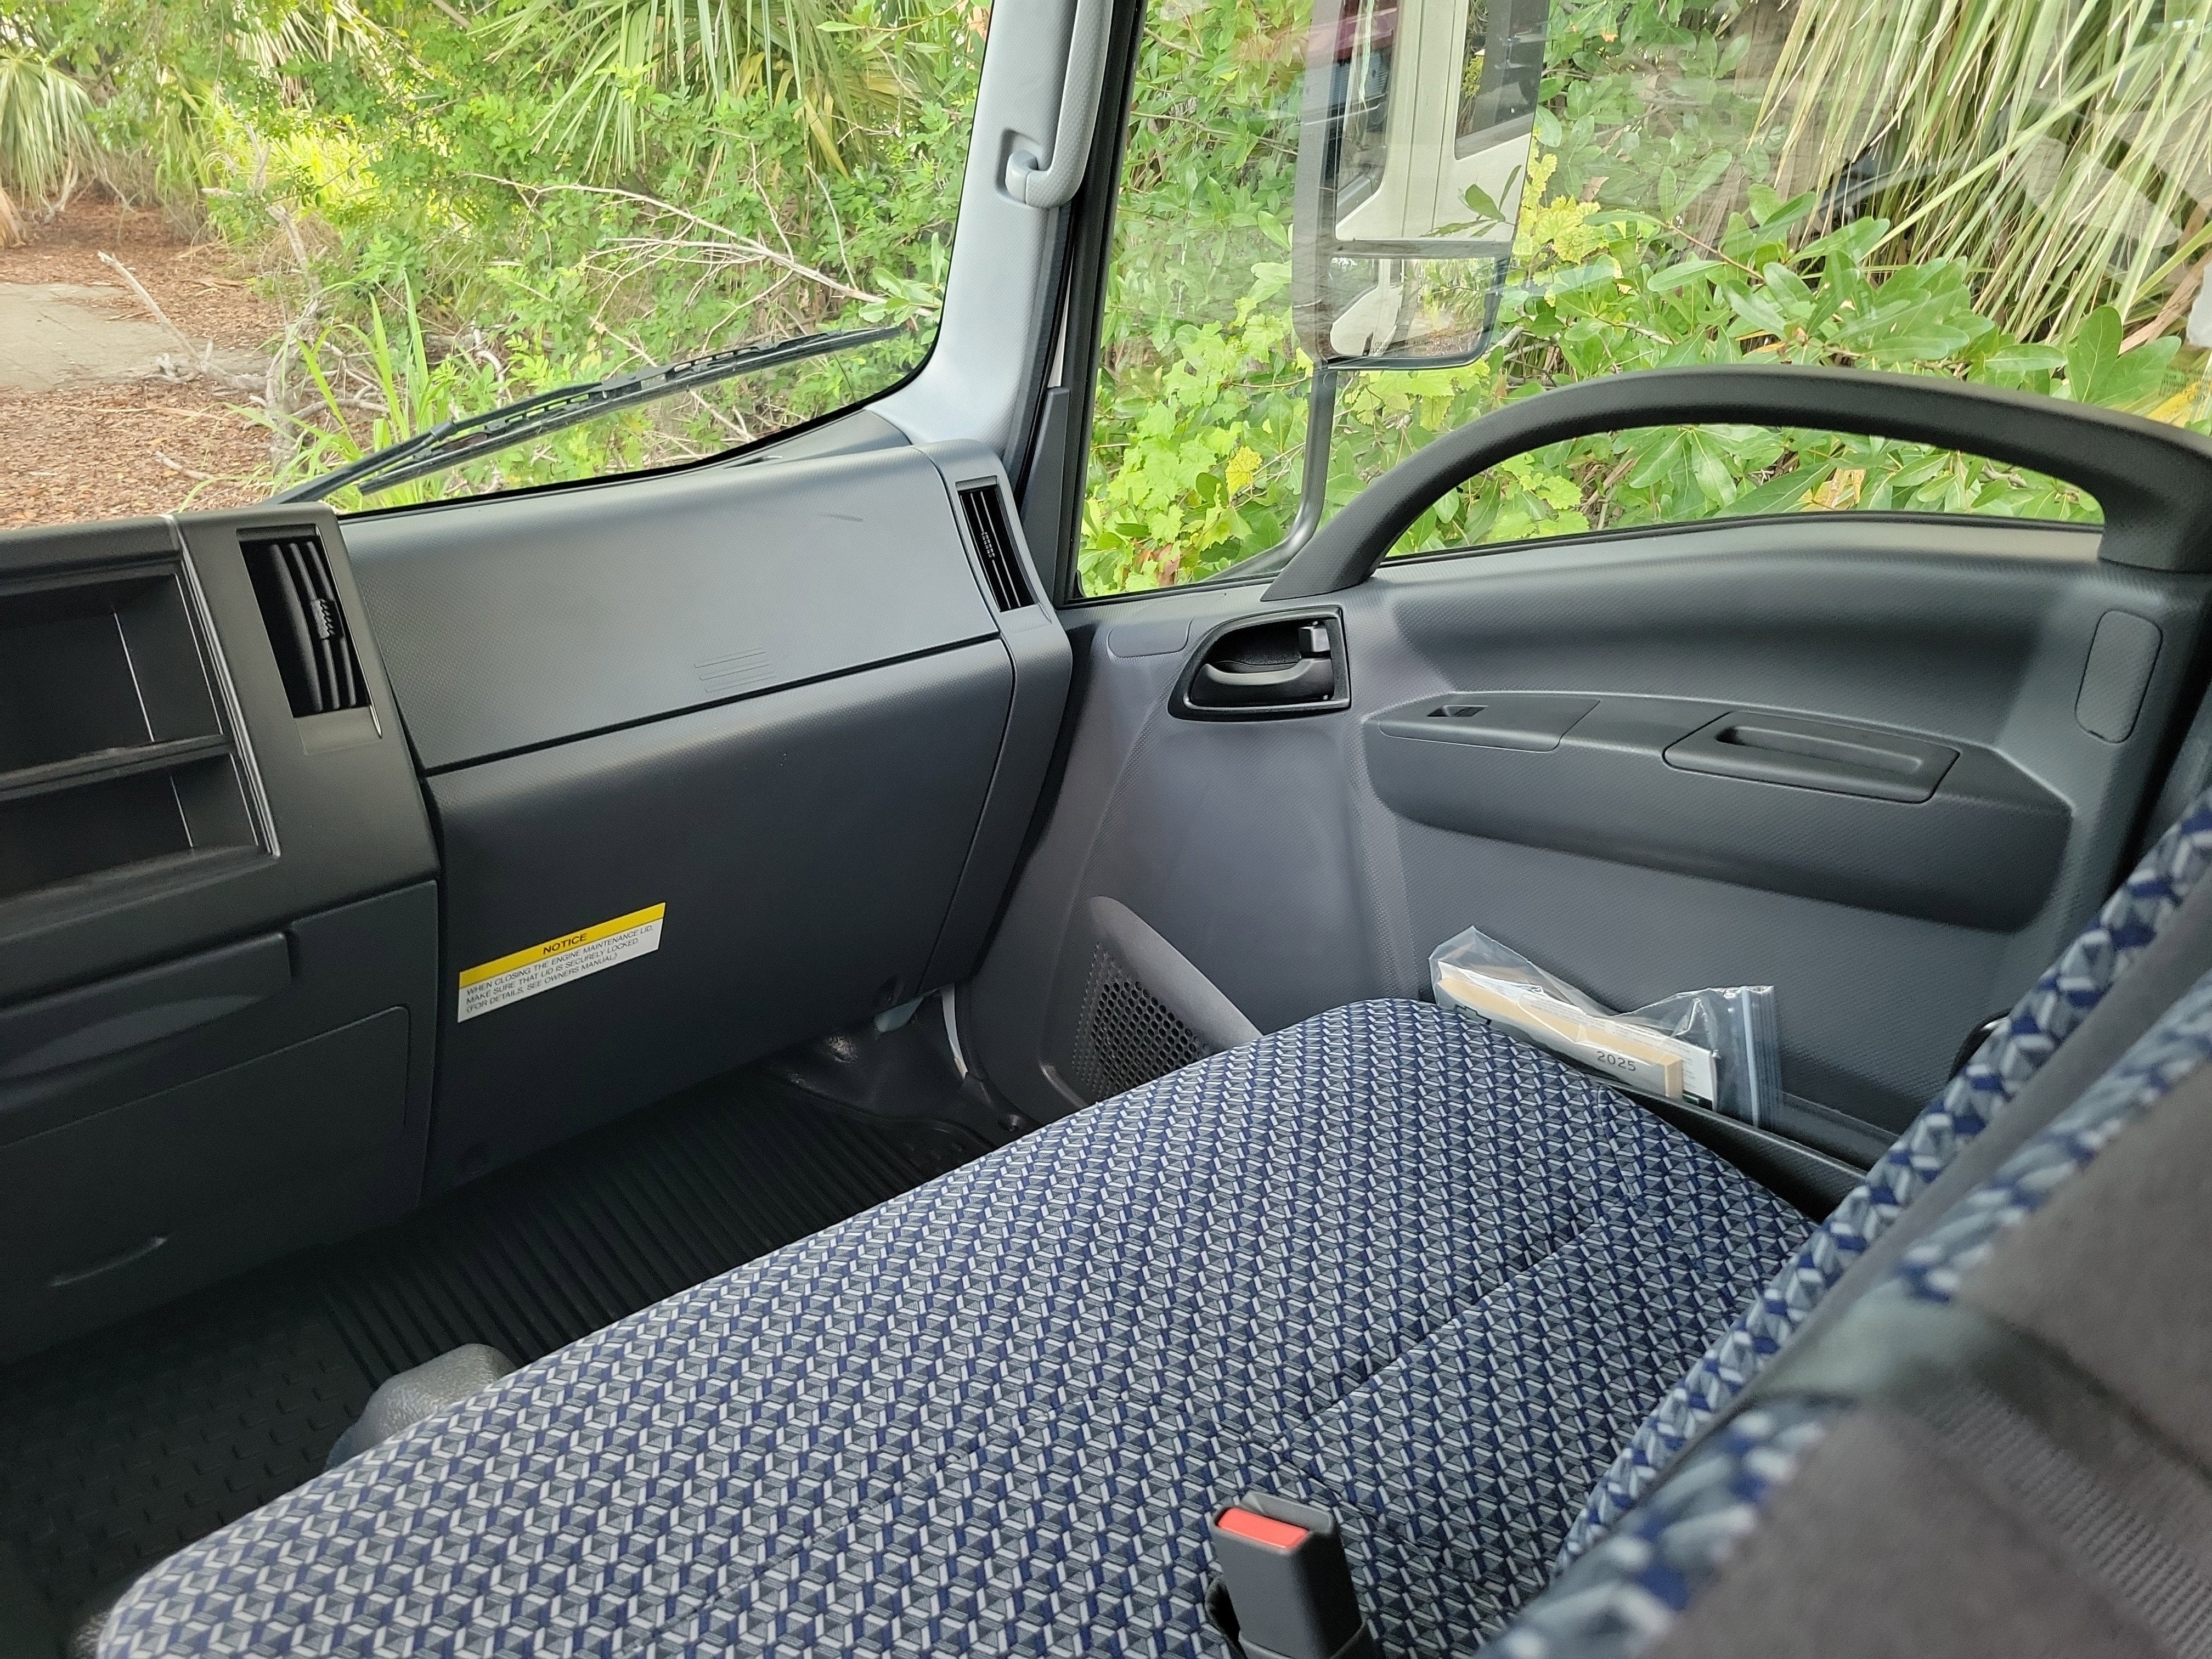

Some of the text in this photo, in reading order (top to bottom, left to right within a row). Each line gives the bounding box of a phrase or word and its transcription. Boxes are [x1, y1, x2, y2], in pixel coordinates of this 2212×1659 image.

[543, 933, 586, 954] NOTICE
[466, 981, 492, 995] WHEN
[494, 968, 530, 985] CLOSING
[534, 962, 548, 971] THE
[552, 950, 580, 964] ENGINE
[583, 930, 638, 953] MAINTENANCE
[466, 990, 490, 1003] MAKE
[493, 981, 515, 994] SURE
[519, 973, 538, 984] THAT
[541, 968, 553, 977] LID
[565, 950, 605, 968] SECURELY
[527, 980, 541, 990] SEE
[1597, 1051, 1636, 1071] 2025
